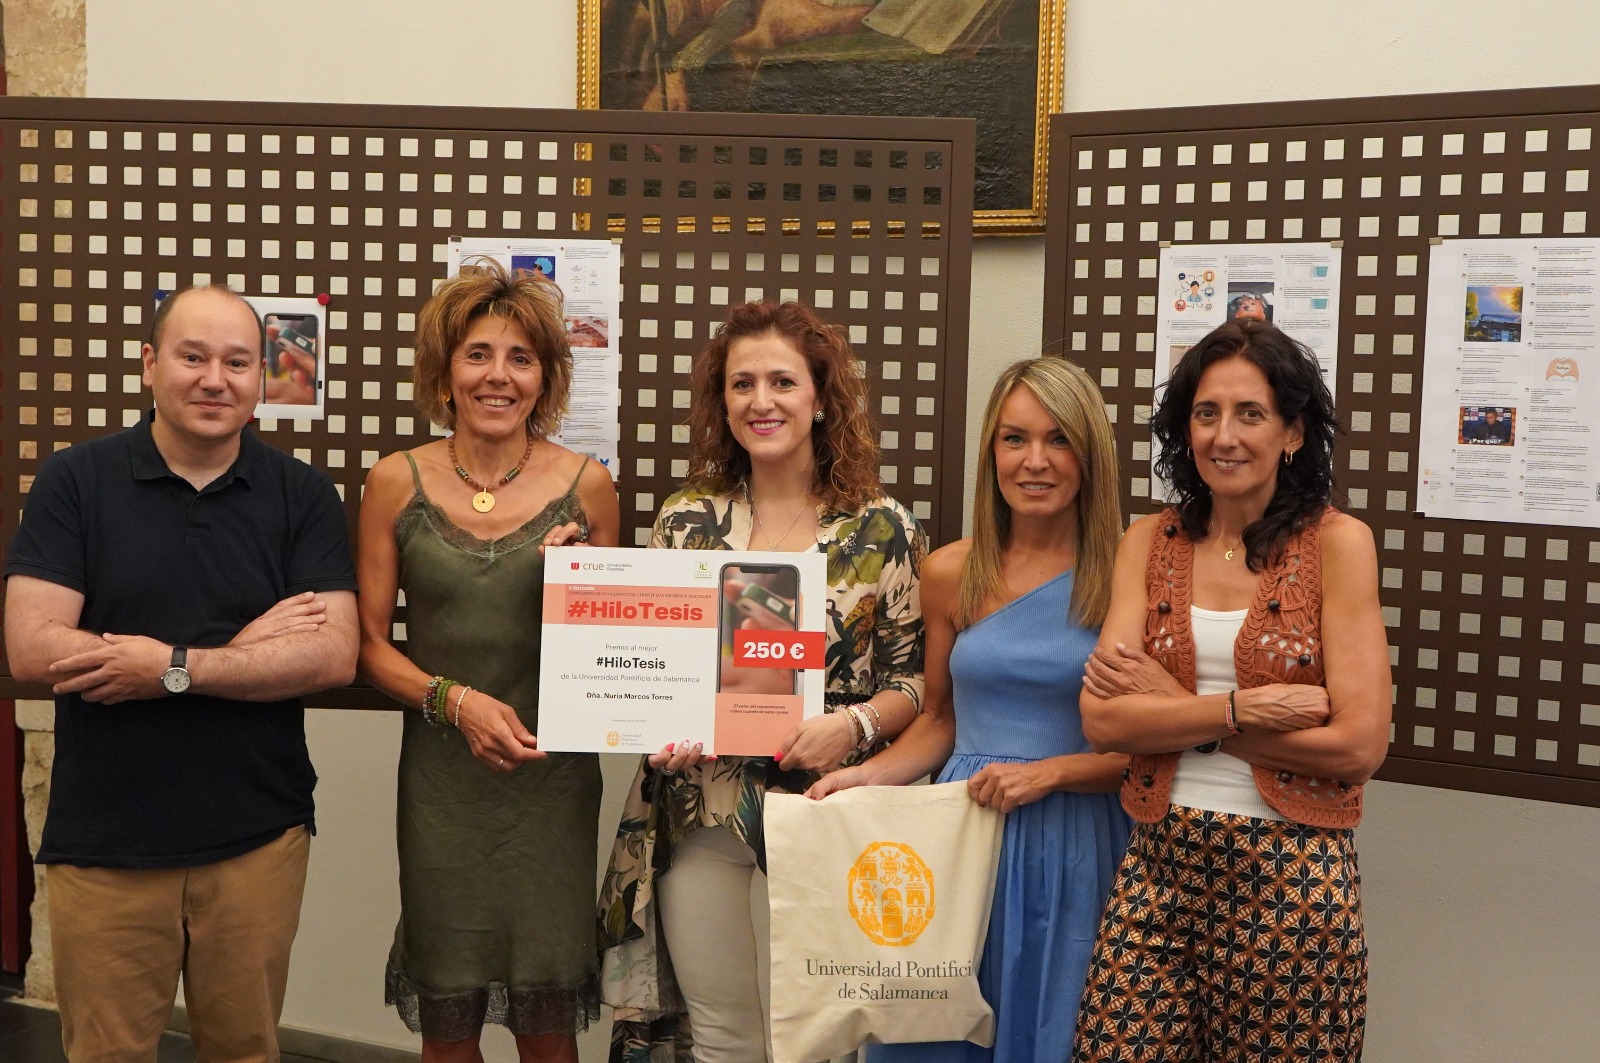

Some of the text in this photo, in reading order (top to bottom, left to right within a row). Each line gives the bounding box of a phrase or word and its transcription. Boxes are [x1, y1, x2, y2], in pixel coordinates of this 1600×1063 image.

[582, 562, 605, 571] crue
[568, 600, 703, 621] #HiloTesis
[743, 641, 805, 660] 250 €
[596, 656, 666, 669] #HiloTesis
[578, 673, 619, 681] Universidad
[620, 674, 652, 682] Pontificia
[663, 675, 700, 683] Salamanca
[604, 692, 623, 700] Nuria
[651, 693, 673, 701] Torres
[806, 958, 972, 978] Universidad Pontifici
[838, 982, 948, 1000] de Salamanca
